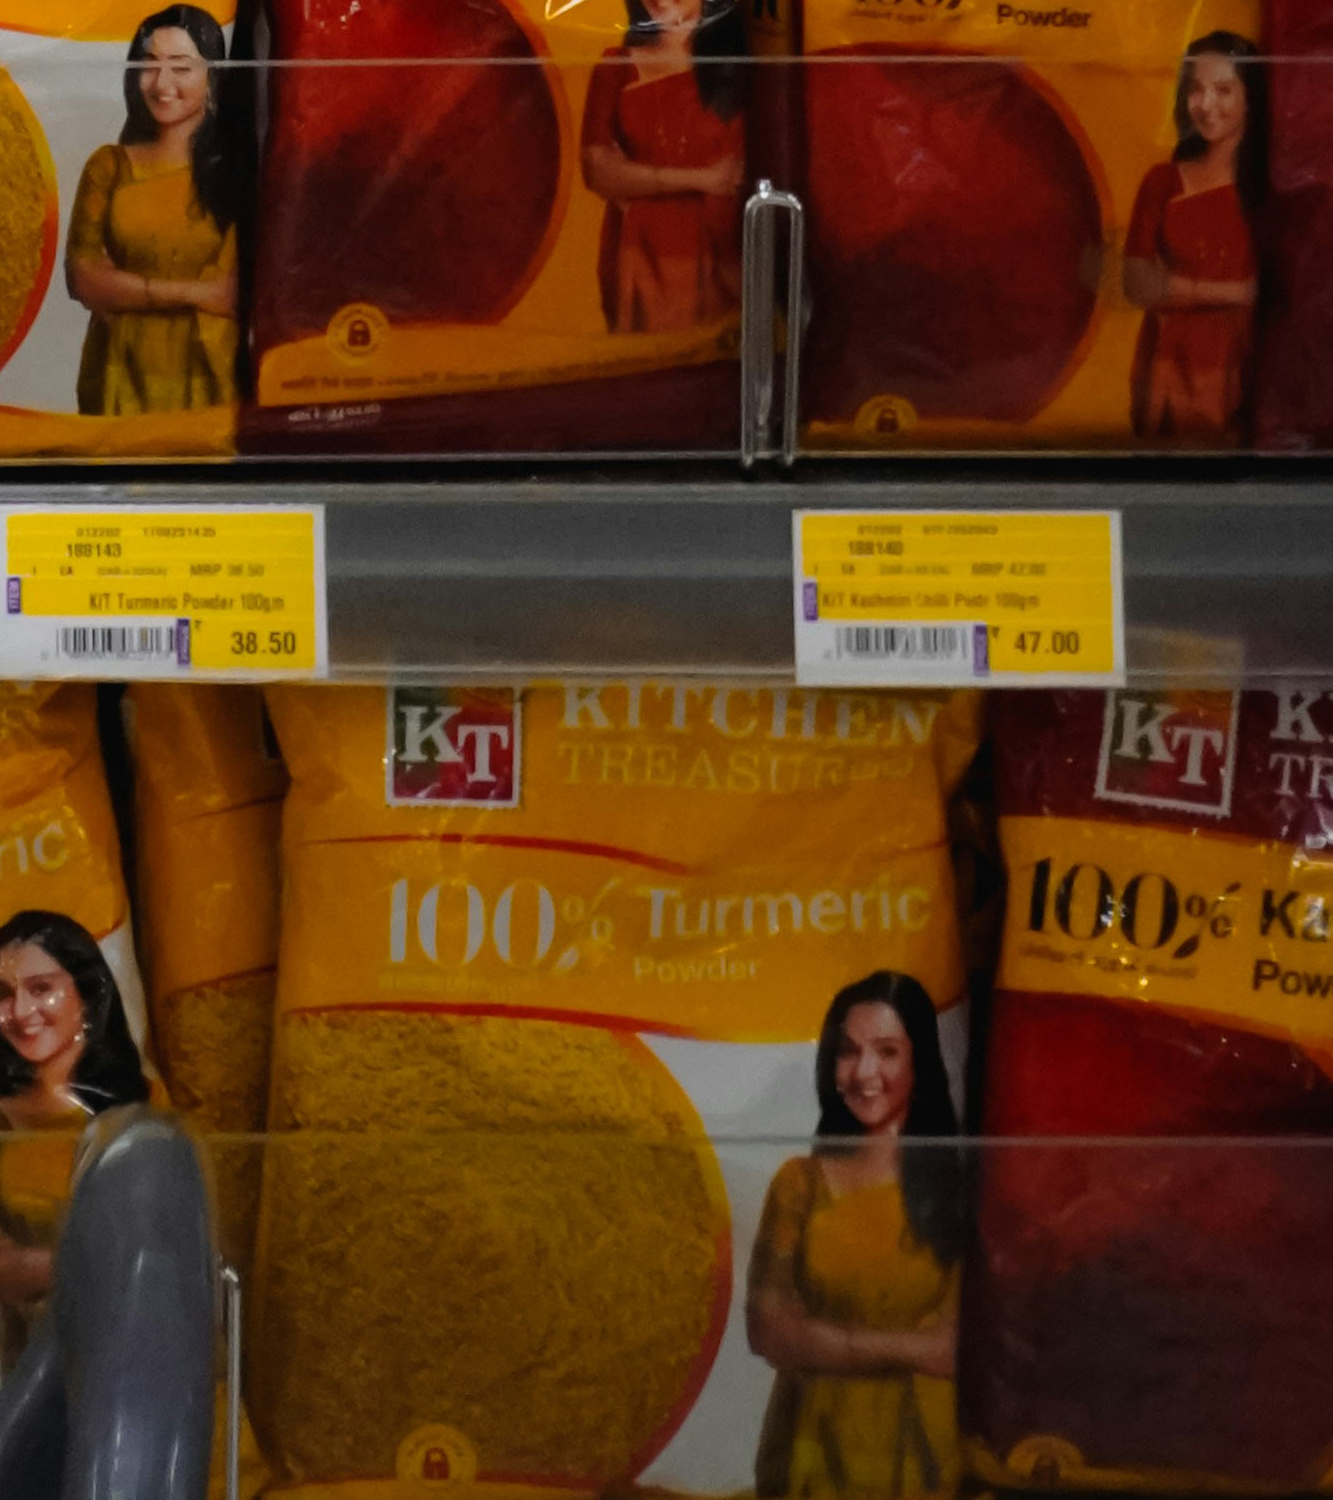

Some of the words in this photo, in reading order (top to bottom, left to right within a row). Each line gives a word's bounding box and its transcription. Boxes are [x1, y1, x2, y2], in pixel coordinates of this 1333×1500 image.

[231, 631, 296, 655] 38.50
[1015, 631, 1080, 654] 47.00
[388, 875, 613, 969] 100%
[637, 883, 929, 942] Turmeric
[632, 955, 761, 984] Powder
